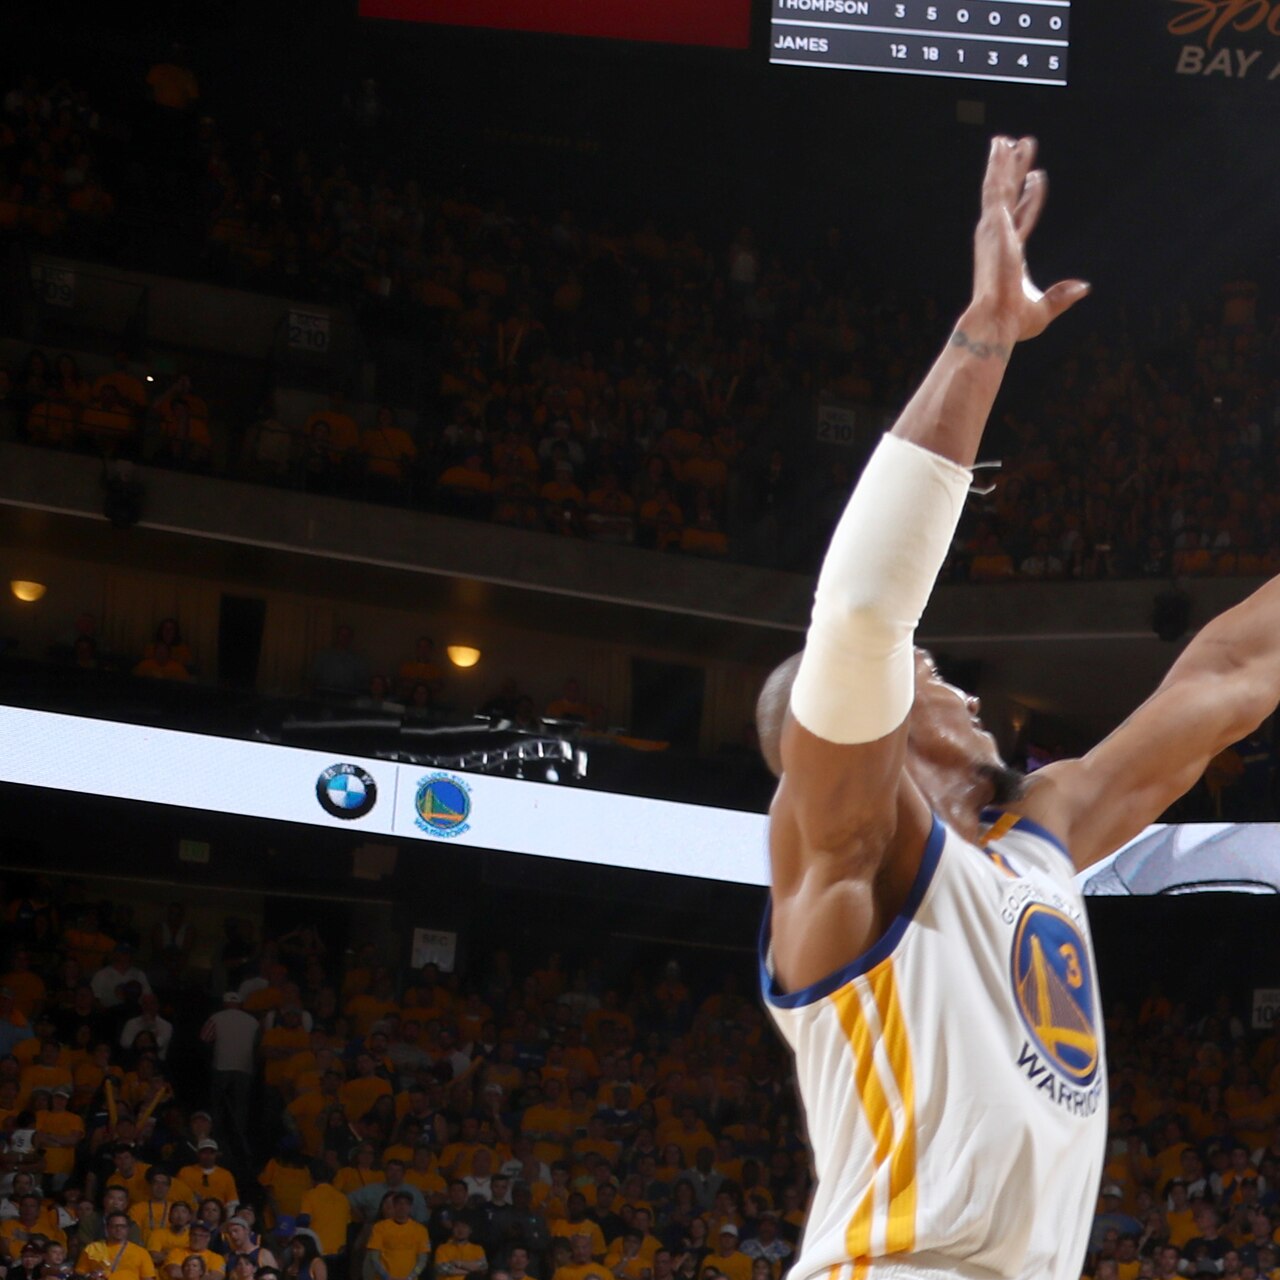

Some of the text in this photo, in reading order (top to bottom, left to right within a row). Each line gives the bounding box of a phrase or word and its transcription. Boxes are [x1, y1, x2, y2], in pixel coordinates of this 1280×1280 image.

[895, 4, 905, 18] 3
[927, 7, 937, 20] 5
[957, 9, 969, 22] 0
[988, 12, 1000, 25] 0
[1018, 14, 1031, 27] 0
[1049, 16, 1061, 30] 0
[774, 35, 1060, 70] JAMES 12 18 1 3 4 5
[1175, 45, 1262, 78] BAY
[289, 326, 326, 347] 210
[818, 421, 854, 440] 210
[421, 933, 449, 947] SEC
[1059, 943, 1083, 988] 3
[1017, 1041, 1102, 1118] WARRIO
